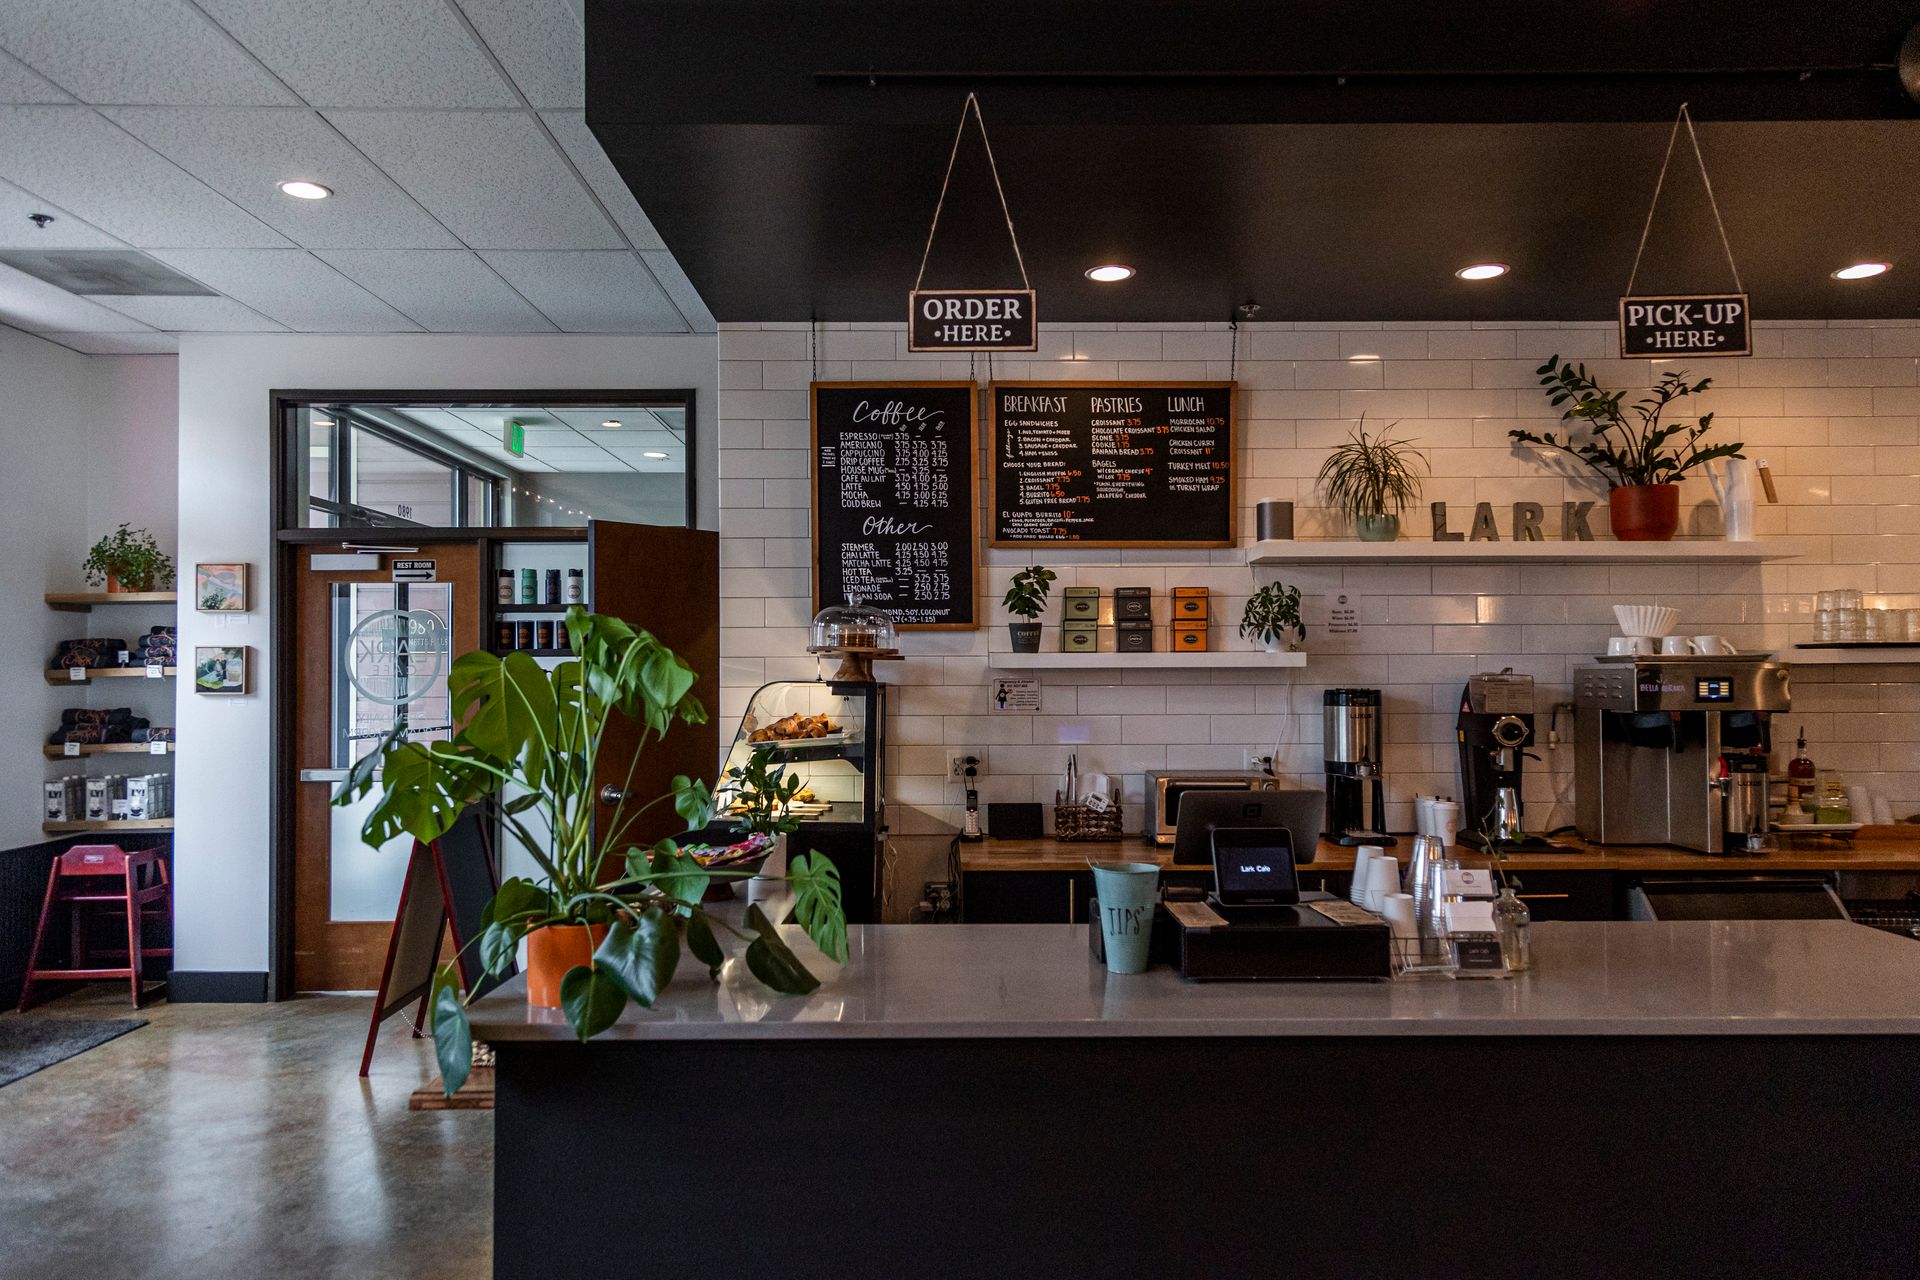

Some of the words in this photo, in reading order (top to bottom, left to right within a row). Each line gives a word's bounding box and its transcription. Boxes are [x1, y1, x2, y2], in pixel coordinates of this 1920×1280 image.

[923, 299, 1022, 320] ORDER
[1628, 304, 1741, 326] PICK-UP
[943, 325, 1003, 342] HERE
[1655, 330, 1716, 348] HERE
[1004, 395, 1067, 412] BREAKFAST
[1091, 397, 1142, 413] PASTRIES
[1168, 397, 1204, 412] LUNCH
[853, 401, 944, 425] Coffee
[840, 441, 882, 449] AMERICANO
[895, 441, 910, 449] 3.75
[912, 441, 927, 449] 3.75
[931, 441, 947, 449] 3.75
[841, 466, 866, 474] HOUSE
[868, 466, 884, 474] MUG
[912, 466, 930, 474] 3.25
[932, 458, 948, 466] 3.75
[862, 516, 933, 535] Other
[1431, 502, 1595, 541] LARK
[842, 543, 874, 551] STEAMER
[896, 542, 912, 550] 2.00
[915, 574, 930, 582] 3.25
[934, 574, 949, 582] 3.75
[915, 583, 931, 591] 2.50
[934, 583, 950, 591] 2.75
[1108, 906, 1144, 936] TIPS
